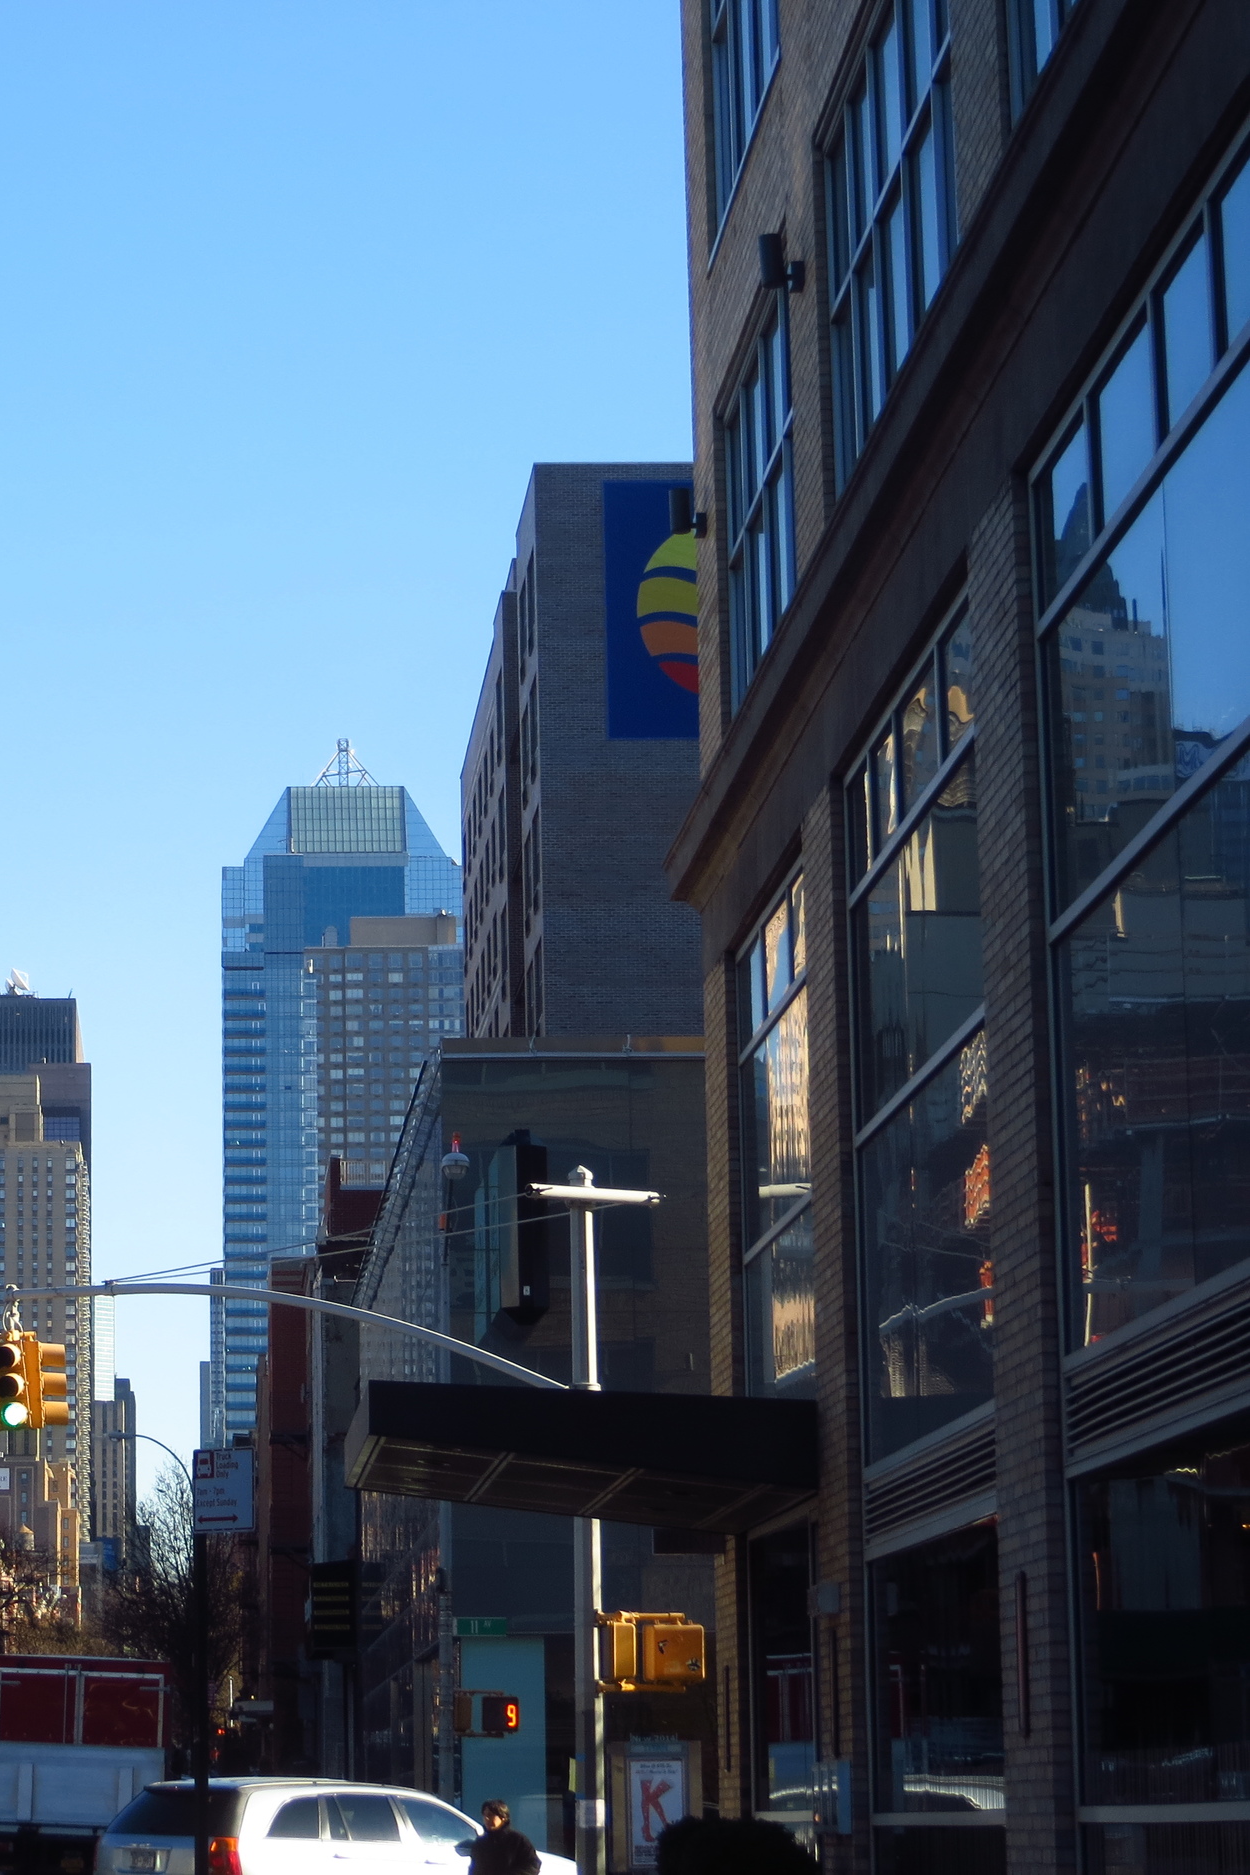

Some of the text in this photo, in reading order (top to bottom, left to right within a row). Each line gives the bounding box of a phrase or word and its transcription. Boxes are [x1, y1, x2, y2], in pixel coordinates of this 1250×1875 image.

[216, 1462, 238, 1470] Loading
[216, 1471, 229, 1479] Only
[197, 1498, 237, 1507] Except Sunday
[470, 1620, 478, 1633] 11
[506, 1703, 517, 1727] 9
